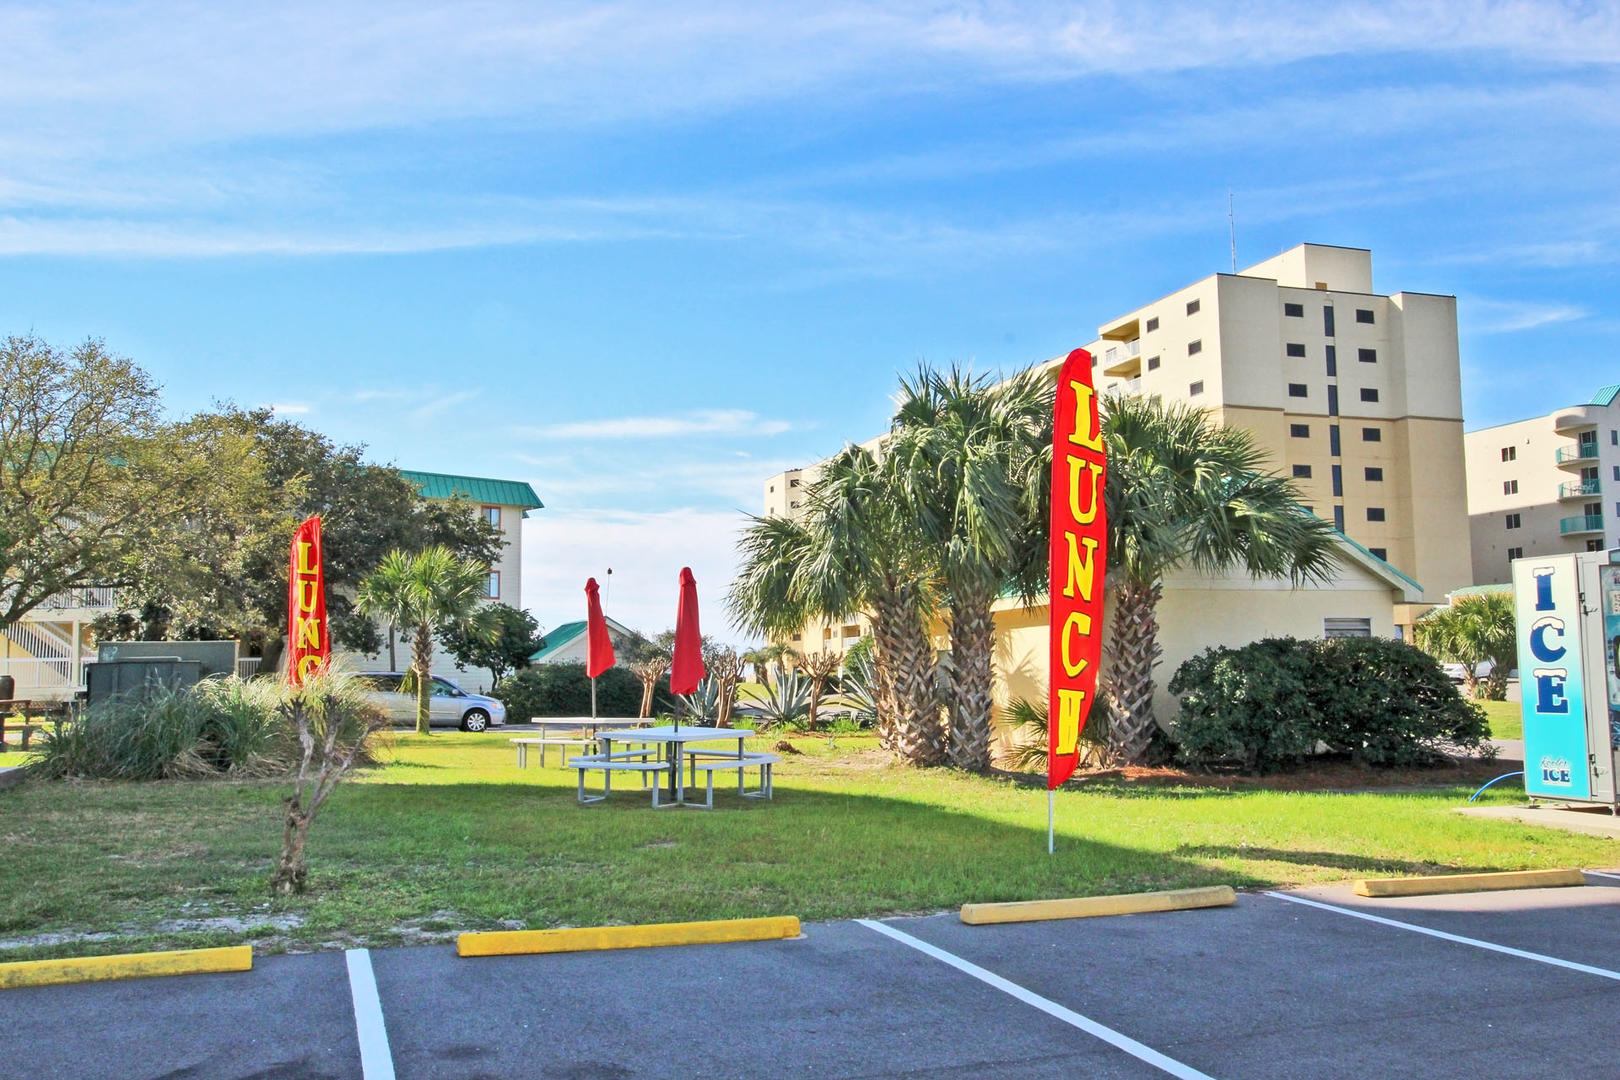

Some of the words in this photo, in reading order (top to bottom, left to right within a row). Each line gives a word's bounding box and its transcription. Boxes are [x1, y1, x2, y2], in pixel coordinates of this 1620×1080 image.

[1056, 380, 1104, 756] LUNCH
[1529, 567, 1569, 714] ICE
[1543, 769, 1570, 782] ICE
